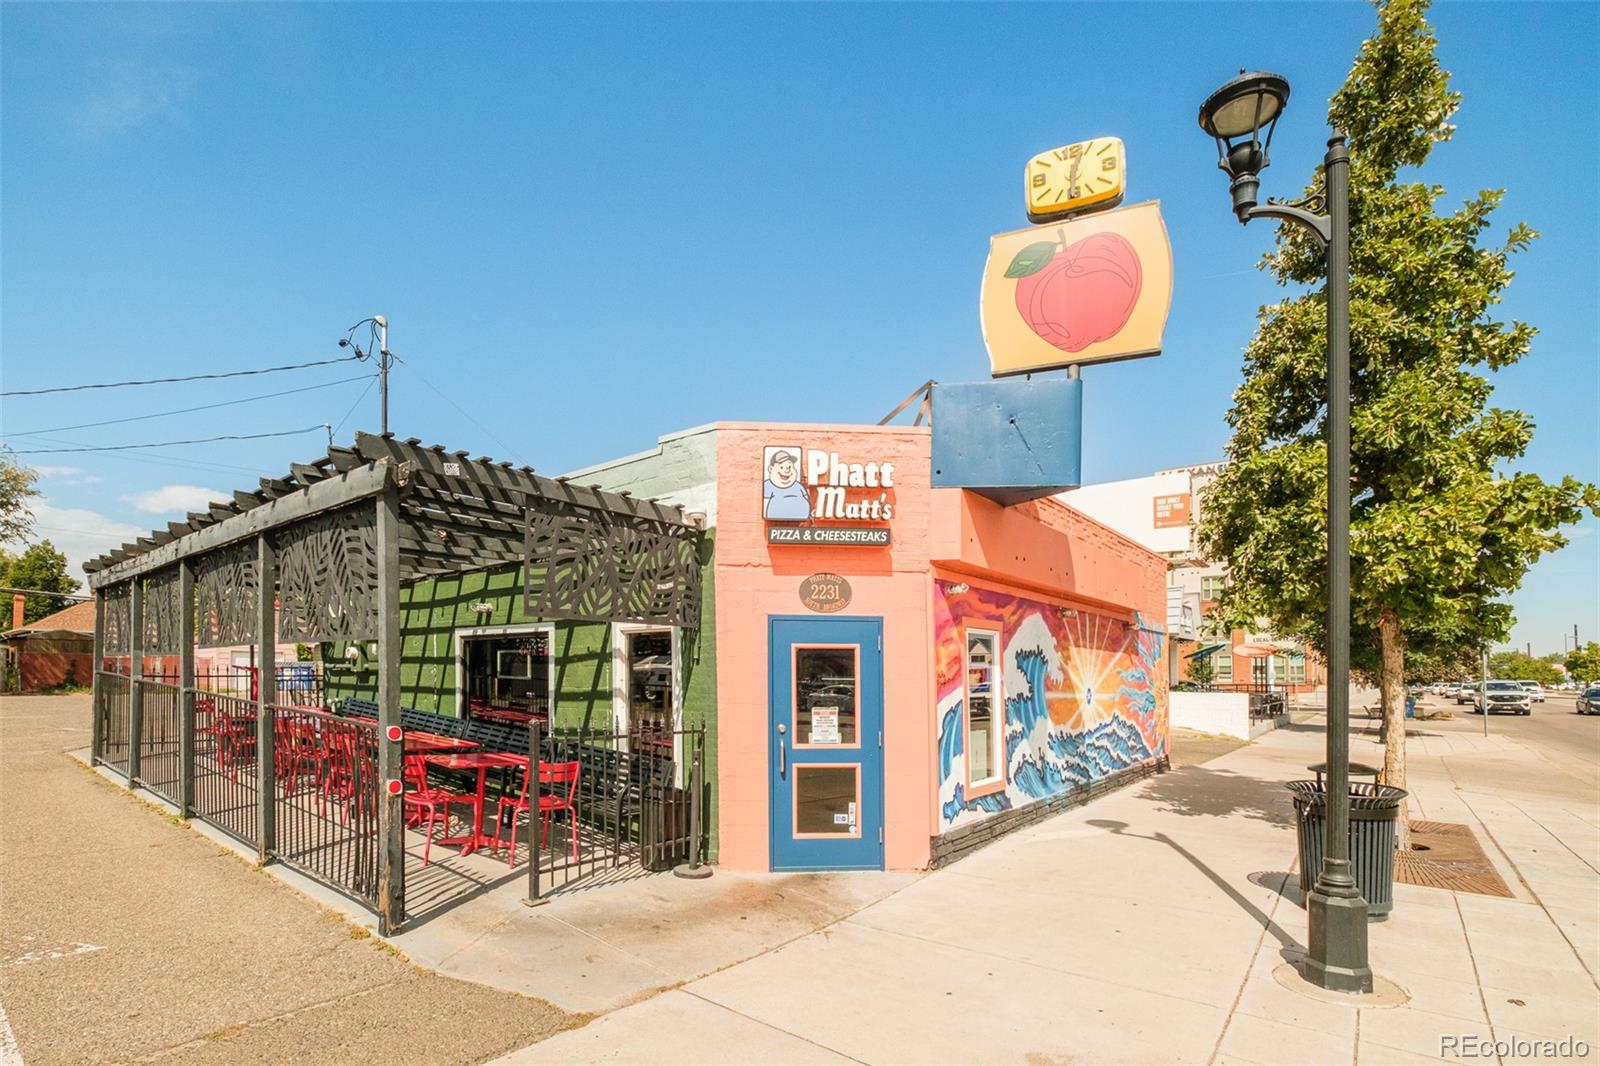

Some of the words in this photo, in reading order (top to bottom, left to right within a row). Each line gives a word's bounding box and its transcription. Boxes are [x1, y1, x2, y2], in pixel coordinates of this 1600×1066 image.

[1062, 144, 1082, 160] 12
[1102, 157, 1116, 171] 3
[1033, 173, 1046, 188] 9
[807, 449, 895, 488] Phatt
[812, 486, 892, 520] Matt's
[770, 529, 800, 541] PIZZA
[803, 530, 811, 541] &
[814, 530, 887, 542] CHEESESTEAKS
[811, 584, 841, 600] 2231
